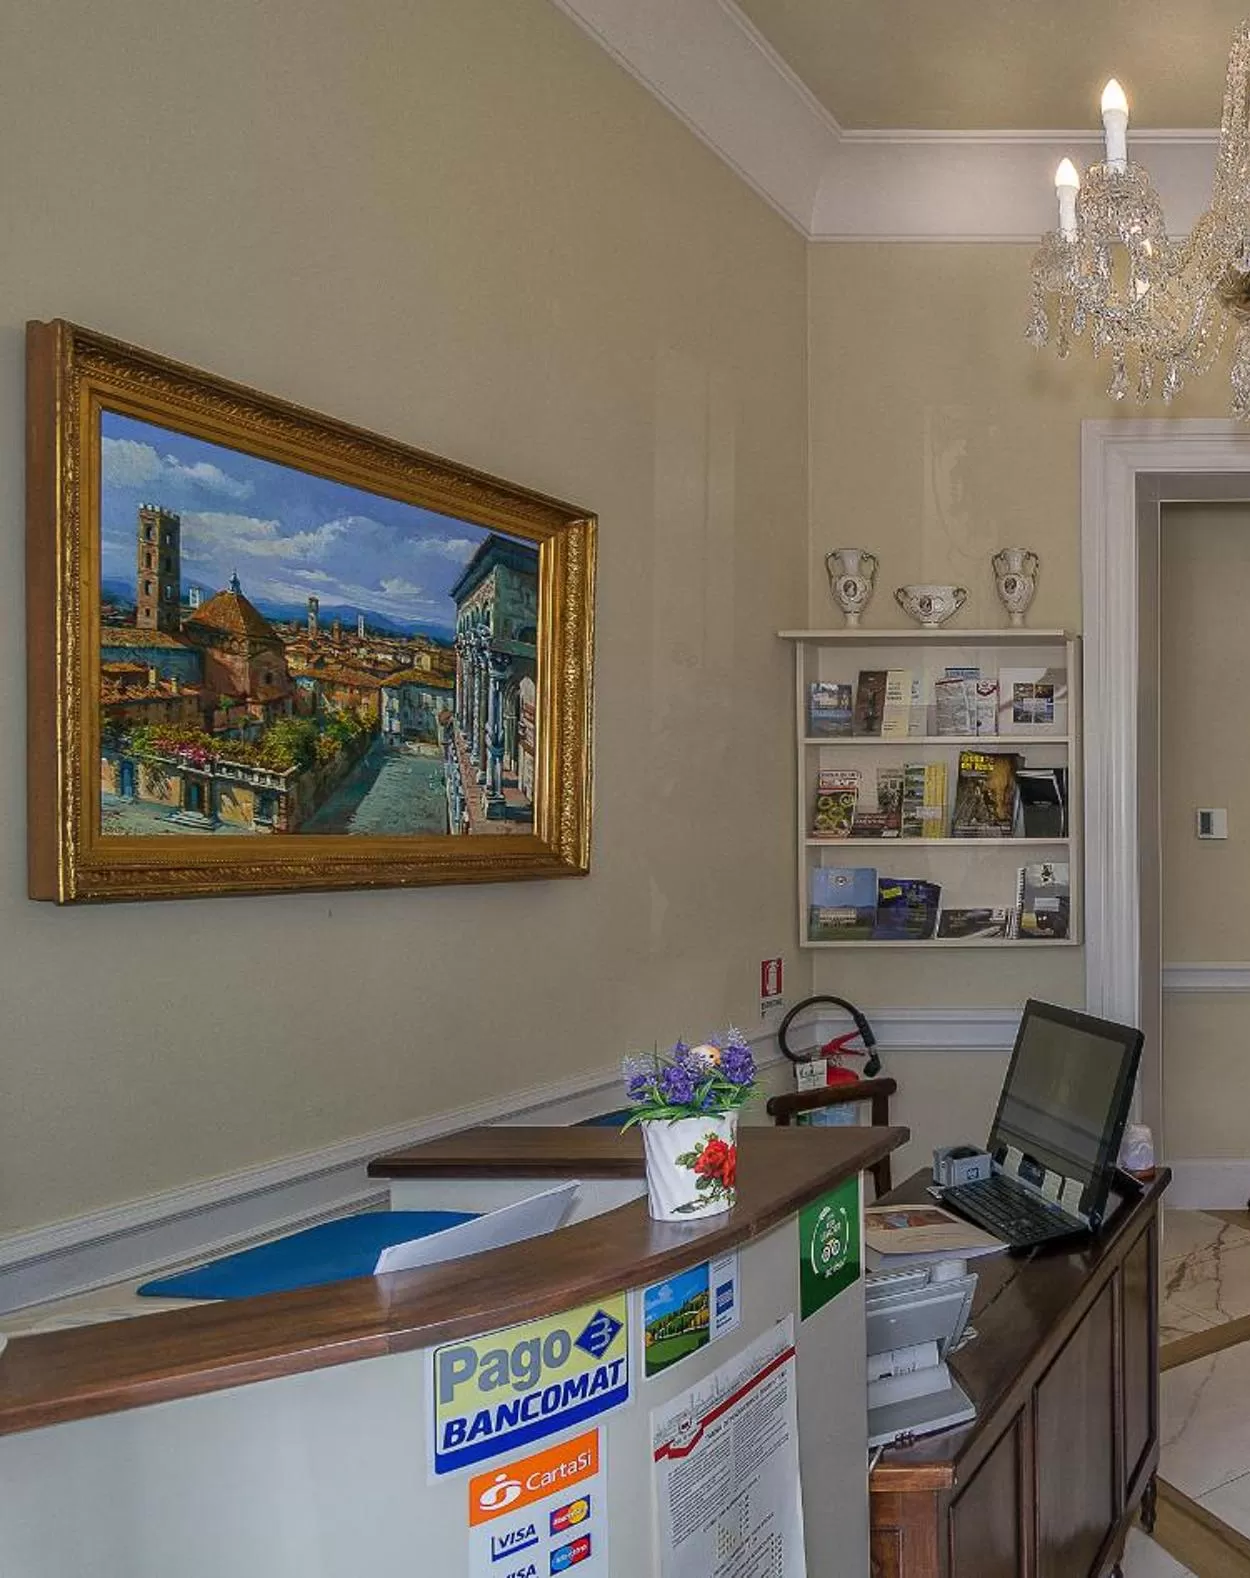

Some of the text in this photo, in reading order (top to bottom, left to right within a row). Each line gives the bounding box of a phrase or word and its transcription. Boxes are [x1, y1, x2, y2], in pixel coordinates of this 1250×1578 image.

[440, 1329, 571, 1404] Pago
[443, 1358, 625, 1450] BANCOMAT
[526, 1448, 591, 1491] CartaSi
[498, 1523, 536, 1548] VISA
[506, 1563, 536, 1578] ISA
